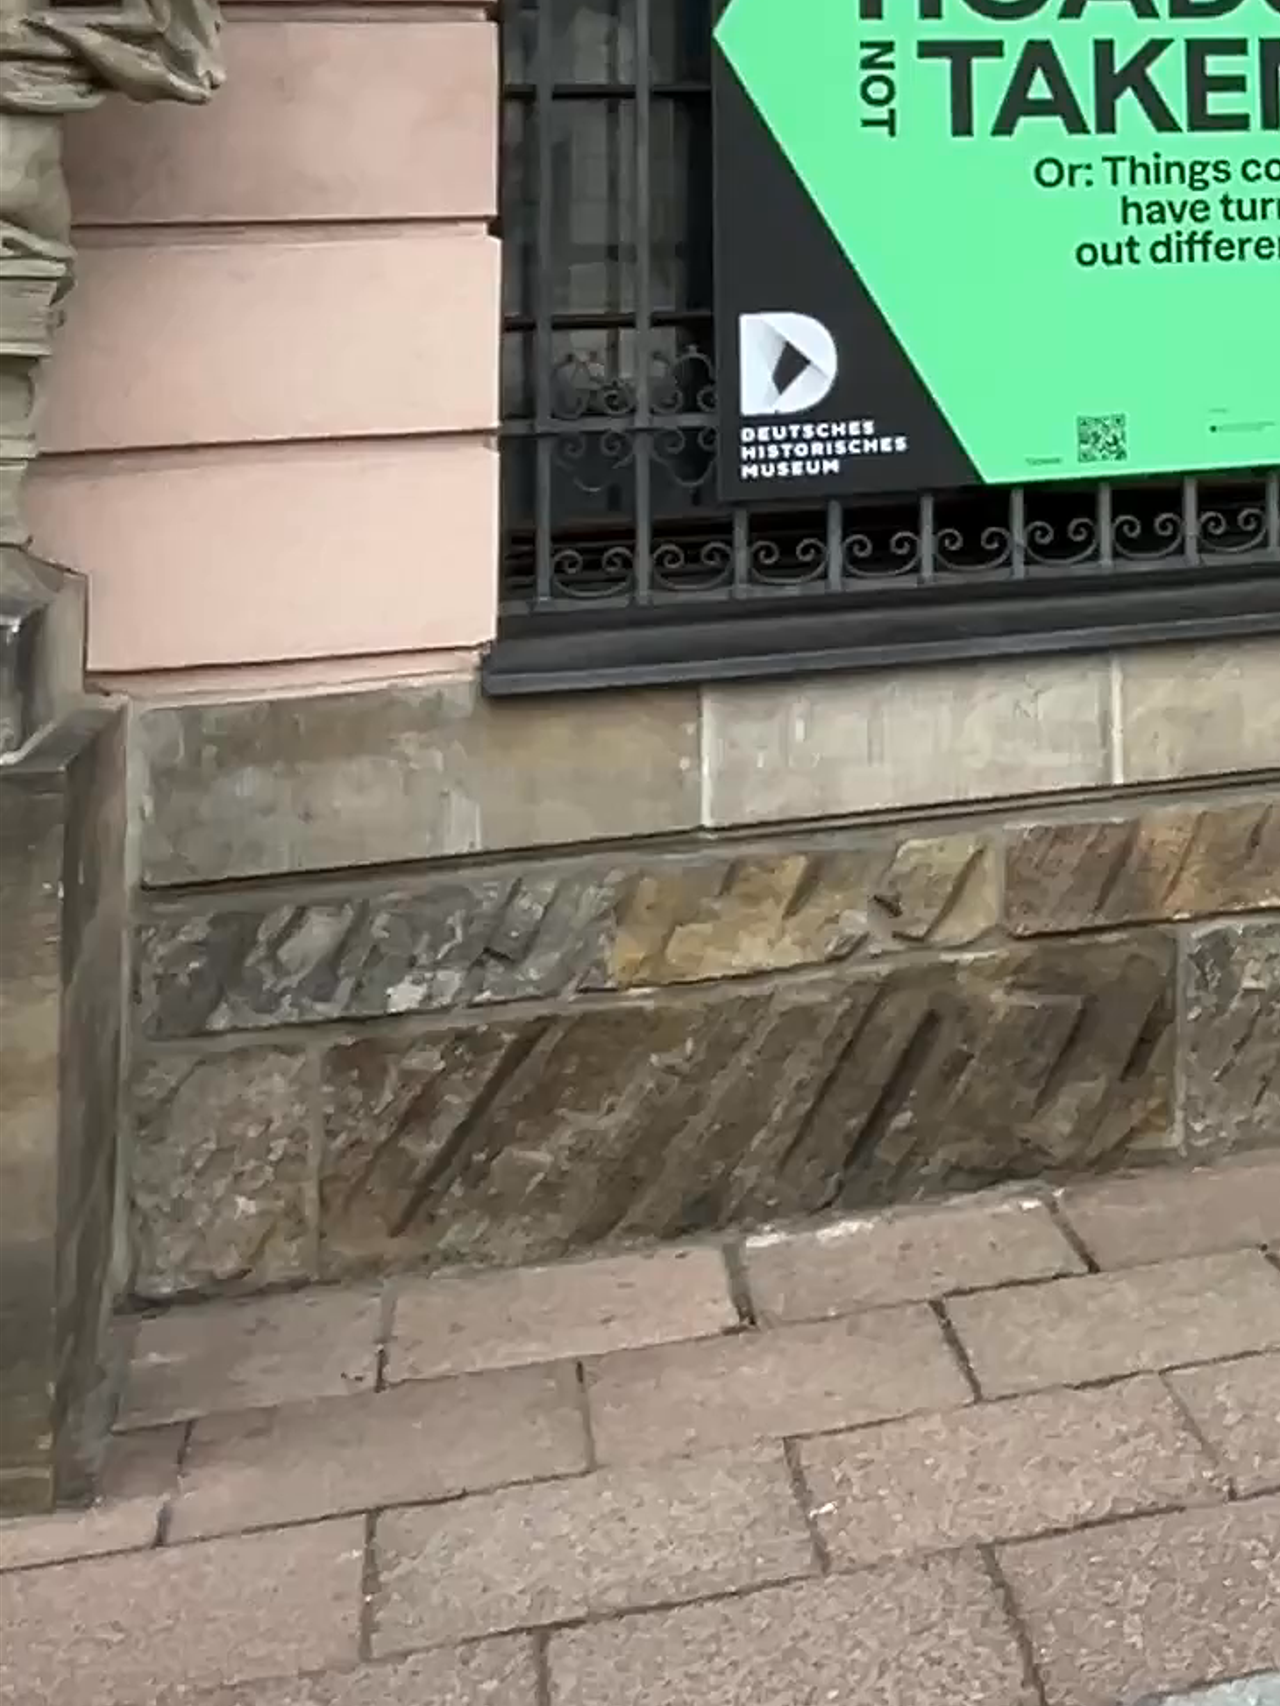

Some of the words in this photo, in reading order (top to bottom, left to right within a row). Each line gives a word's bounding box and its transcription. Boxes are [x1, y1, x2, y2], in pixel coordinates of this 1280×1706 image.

[859, 40, 896, 137] NOT
[1034, 157, 1093, 187] Or:
[1101, 152, 1231, 190] Things
[1121, 194, 1211, 225] have
[1075, 235, 1142, 267] out
[741, 420, 874, 443] DEUTSCHES
[741, 436, 908, 461] HISTORISCHES
[741, 459, 840, 479] MUSEUM
